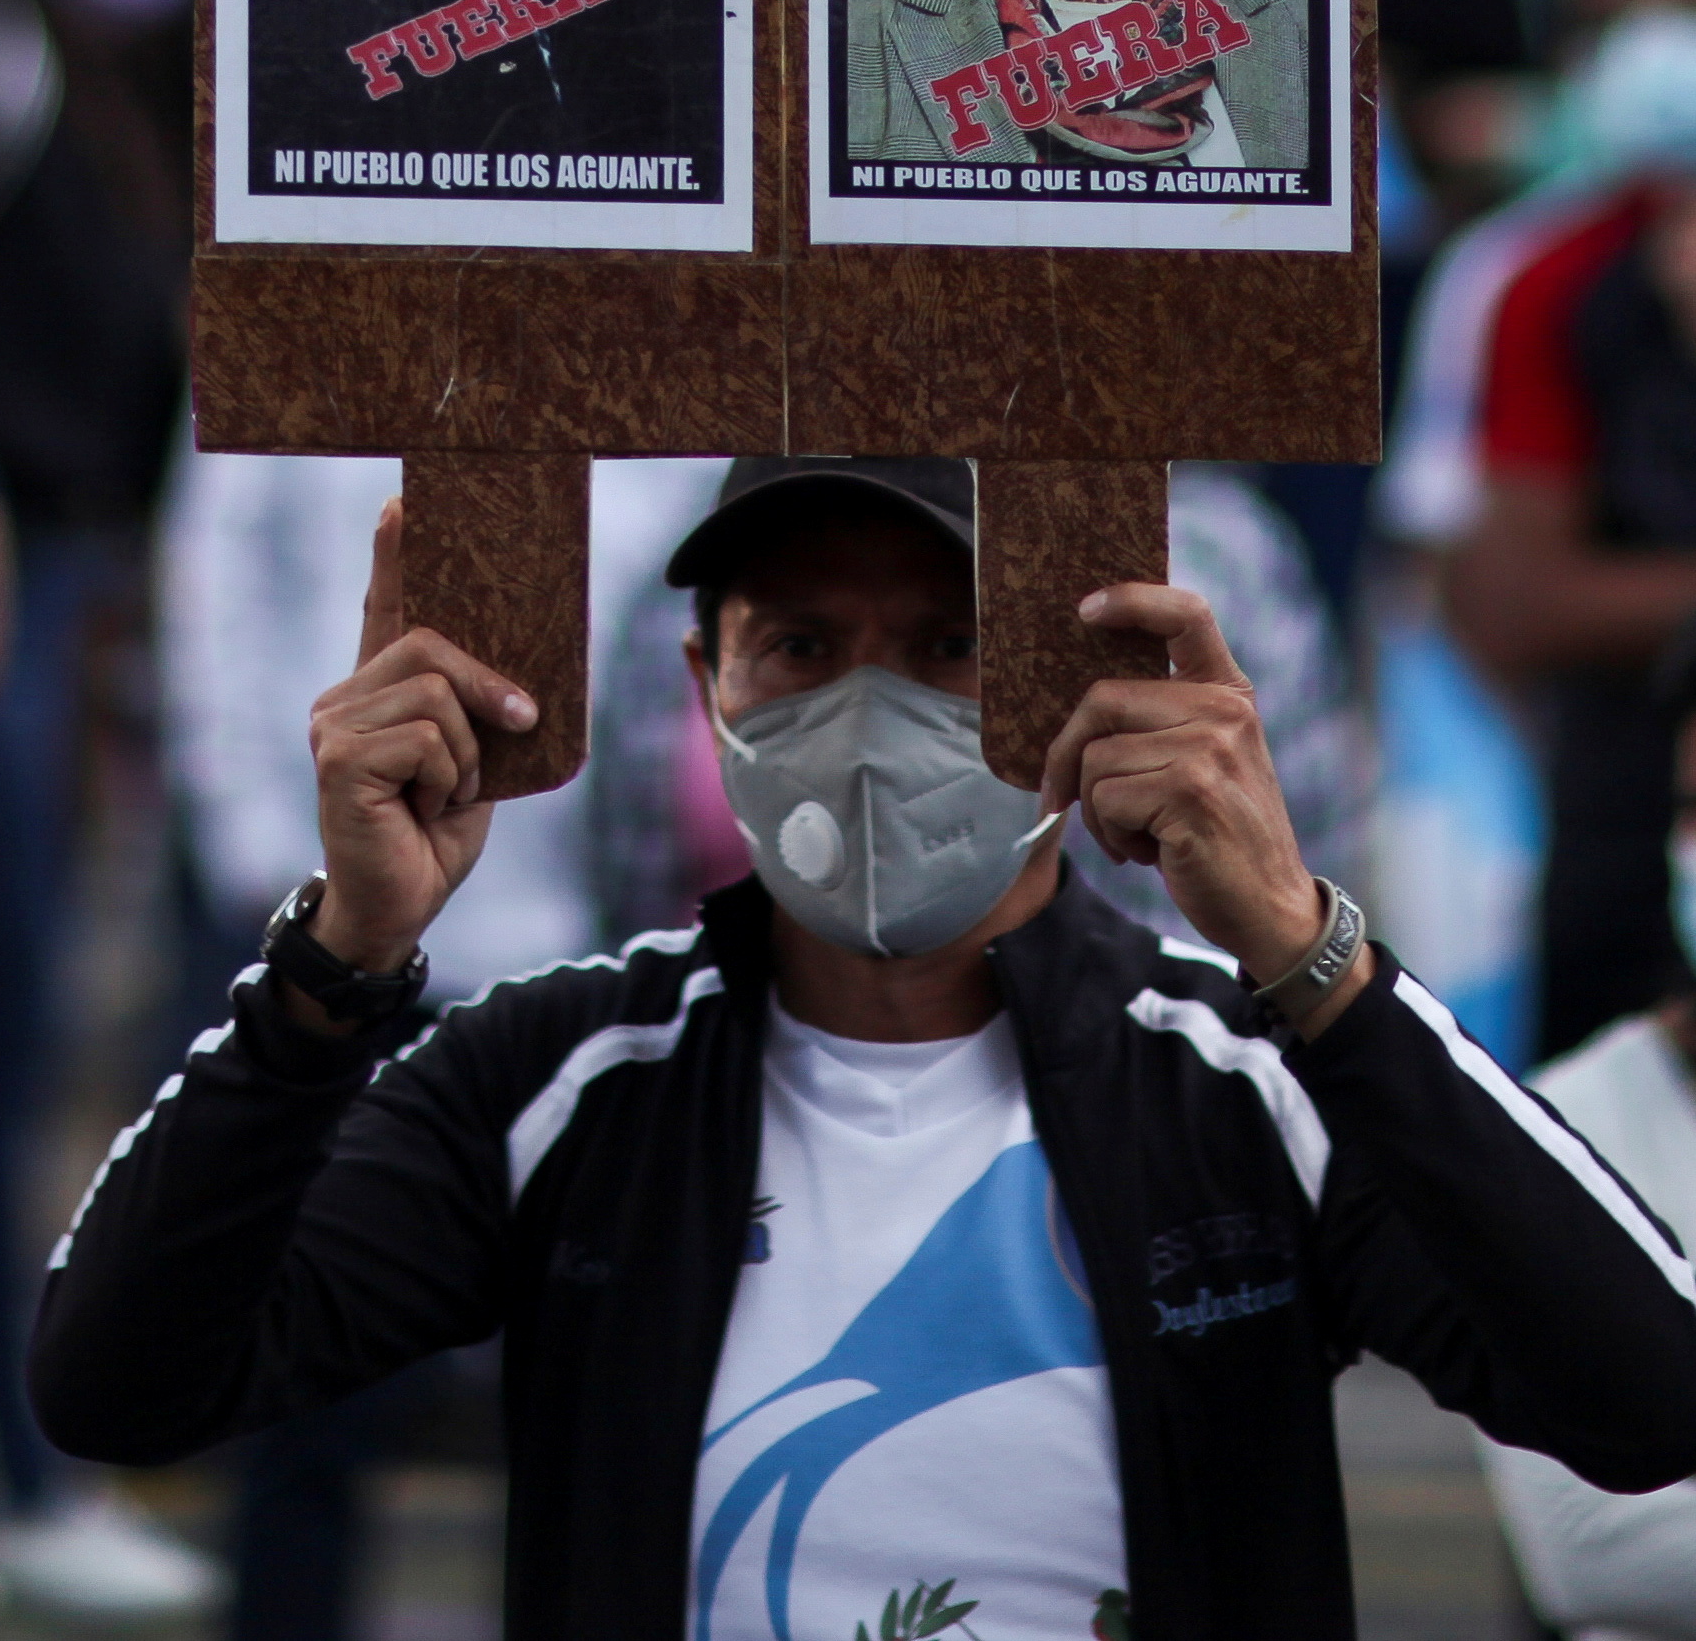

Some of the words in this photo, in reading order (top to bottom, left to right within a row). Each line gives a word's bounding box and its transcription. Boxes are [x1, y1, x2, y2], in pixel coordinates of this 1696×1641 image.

[274, 149, 305, 183] NI
[313, 150, 424, 186] PUEBLO
[431, 152, 489, 189] QUE
[496, 154, 551, 188] LOS
[556, 155, 700, 190] AGUANTE.
[852, 166, 885, 187] NI
[893, 166, 1012, 190] PUEBLO
[1020, 169, 1082, 192] QUE
[1090, 169, 1148, 192] LOS
[1155, 171, 1310, 194] AGUANTE.
